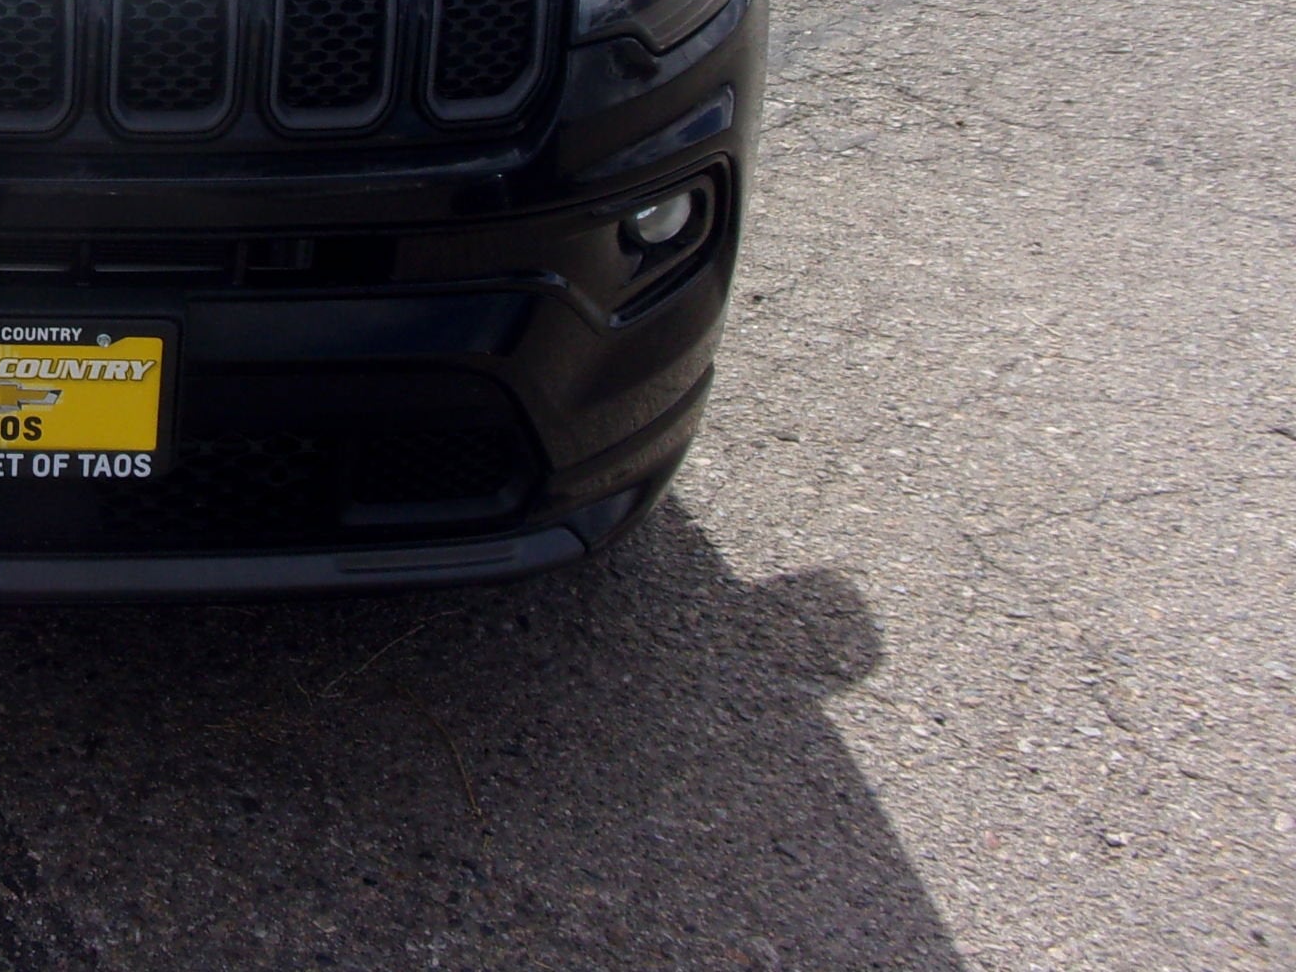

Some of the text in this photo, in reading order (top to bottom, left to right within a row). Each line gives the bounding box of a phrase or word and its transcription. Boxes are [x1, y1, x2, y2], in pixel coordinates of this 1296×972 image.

[1, 327, 83, 342] COUNTRY
[31, 454, 70, 477] OF
[77, 454, 152, 478] TAOS
